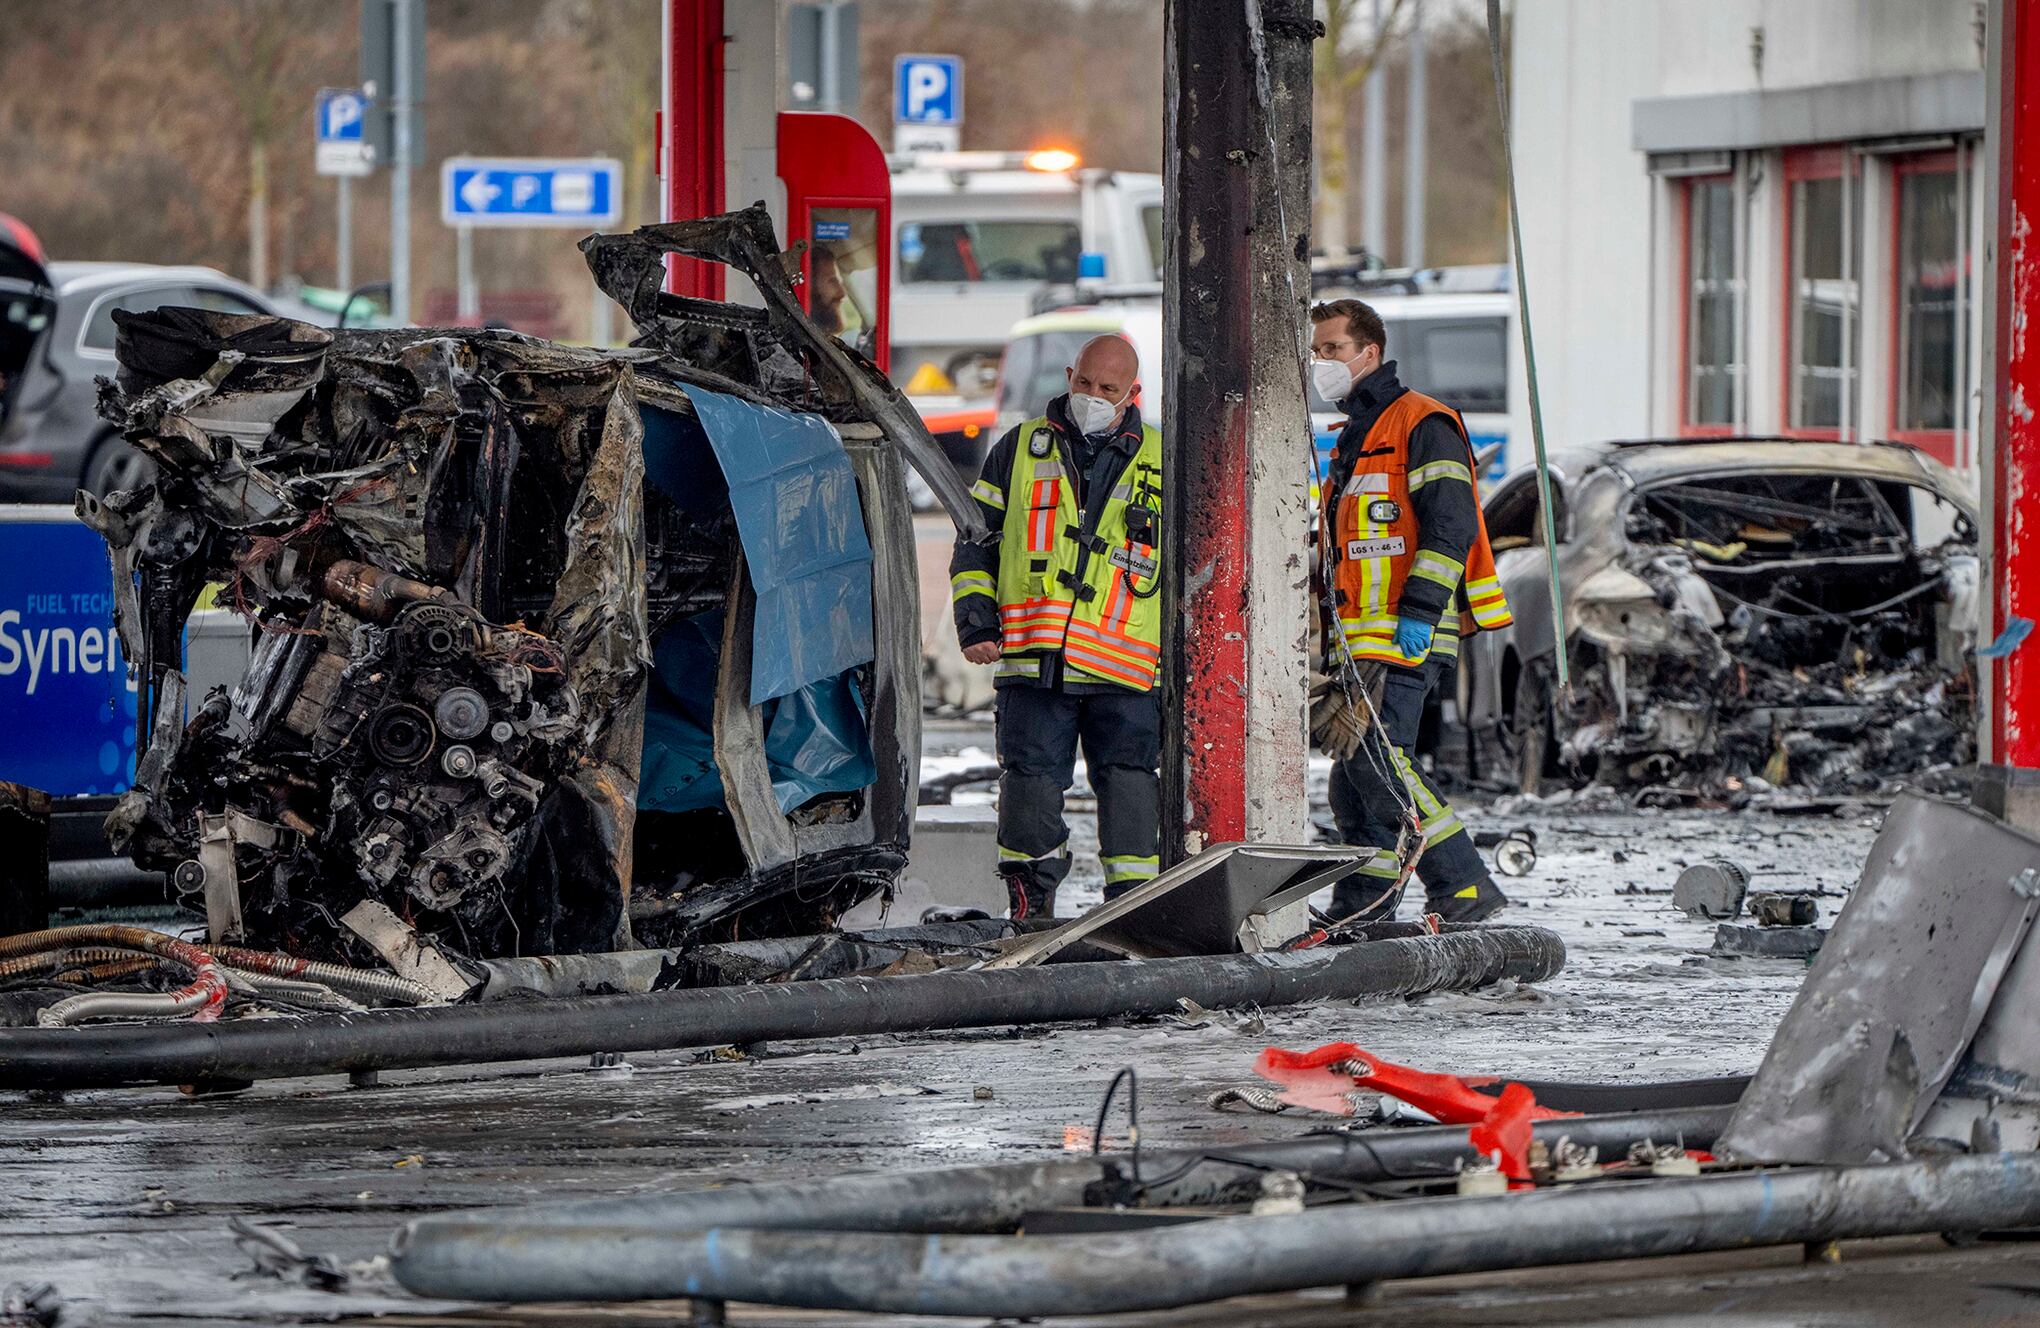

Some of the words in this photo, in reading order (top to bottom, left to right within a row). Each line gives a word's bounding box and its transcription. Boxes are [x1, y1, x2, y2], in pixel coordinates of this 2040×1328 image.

[908, 63, 948, 114] P
[329, 94, 359, 136] P
[512, 174, 541, 209] P
[1351, 546, 1367, 555] LGS
[1381, 543, 1391, 551] 46
[28, 594, 66, 613] FUEL
